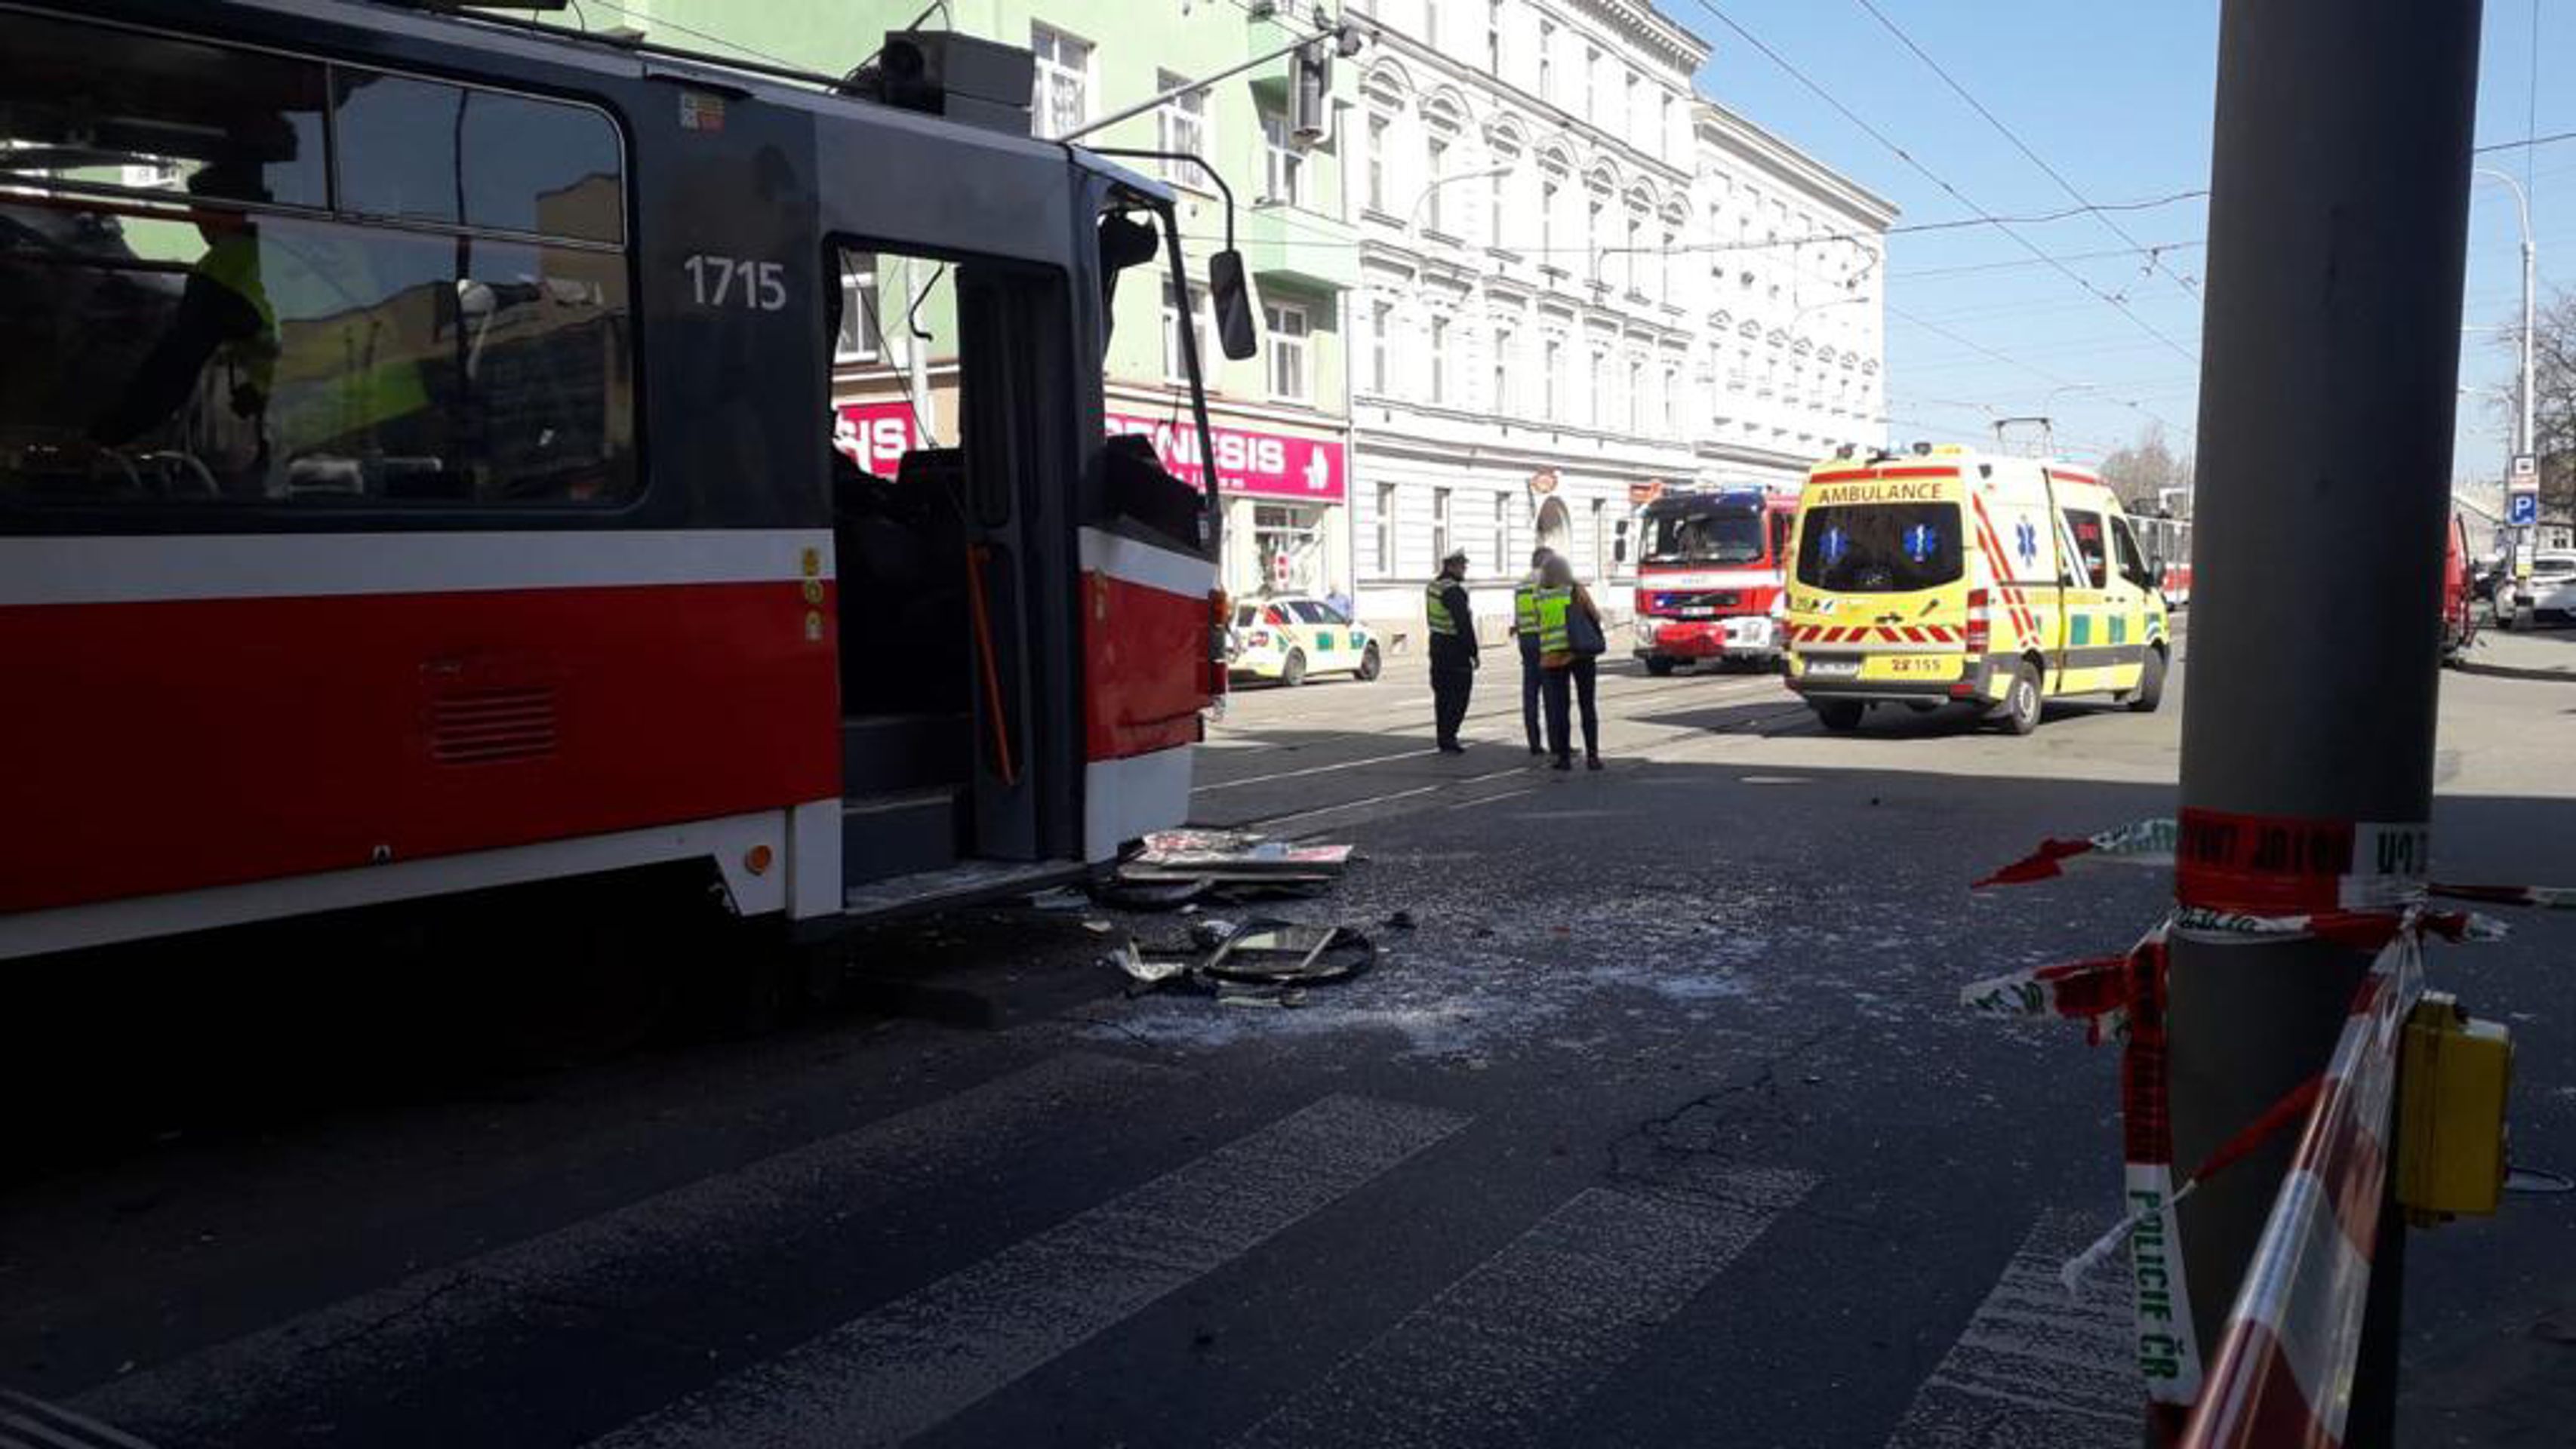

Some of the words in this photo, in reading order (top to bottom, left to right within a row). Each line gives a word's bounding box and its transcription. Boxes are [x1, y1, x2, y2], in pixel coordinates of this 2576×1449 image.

[685, 255, 786, 310] 1715
[1105, 417, 1284, 474] NESIS
[1819, 483, 1943, 504] AMBULANCE
[2516, 497, 2532, 516] P
[2140, 1334, 2184, 1377] ČR
